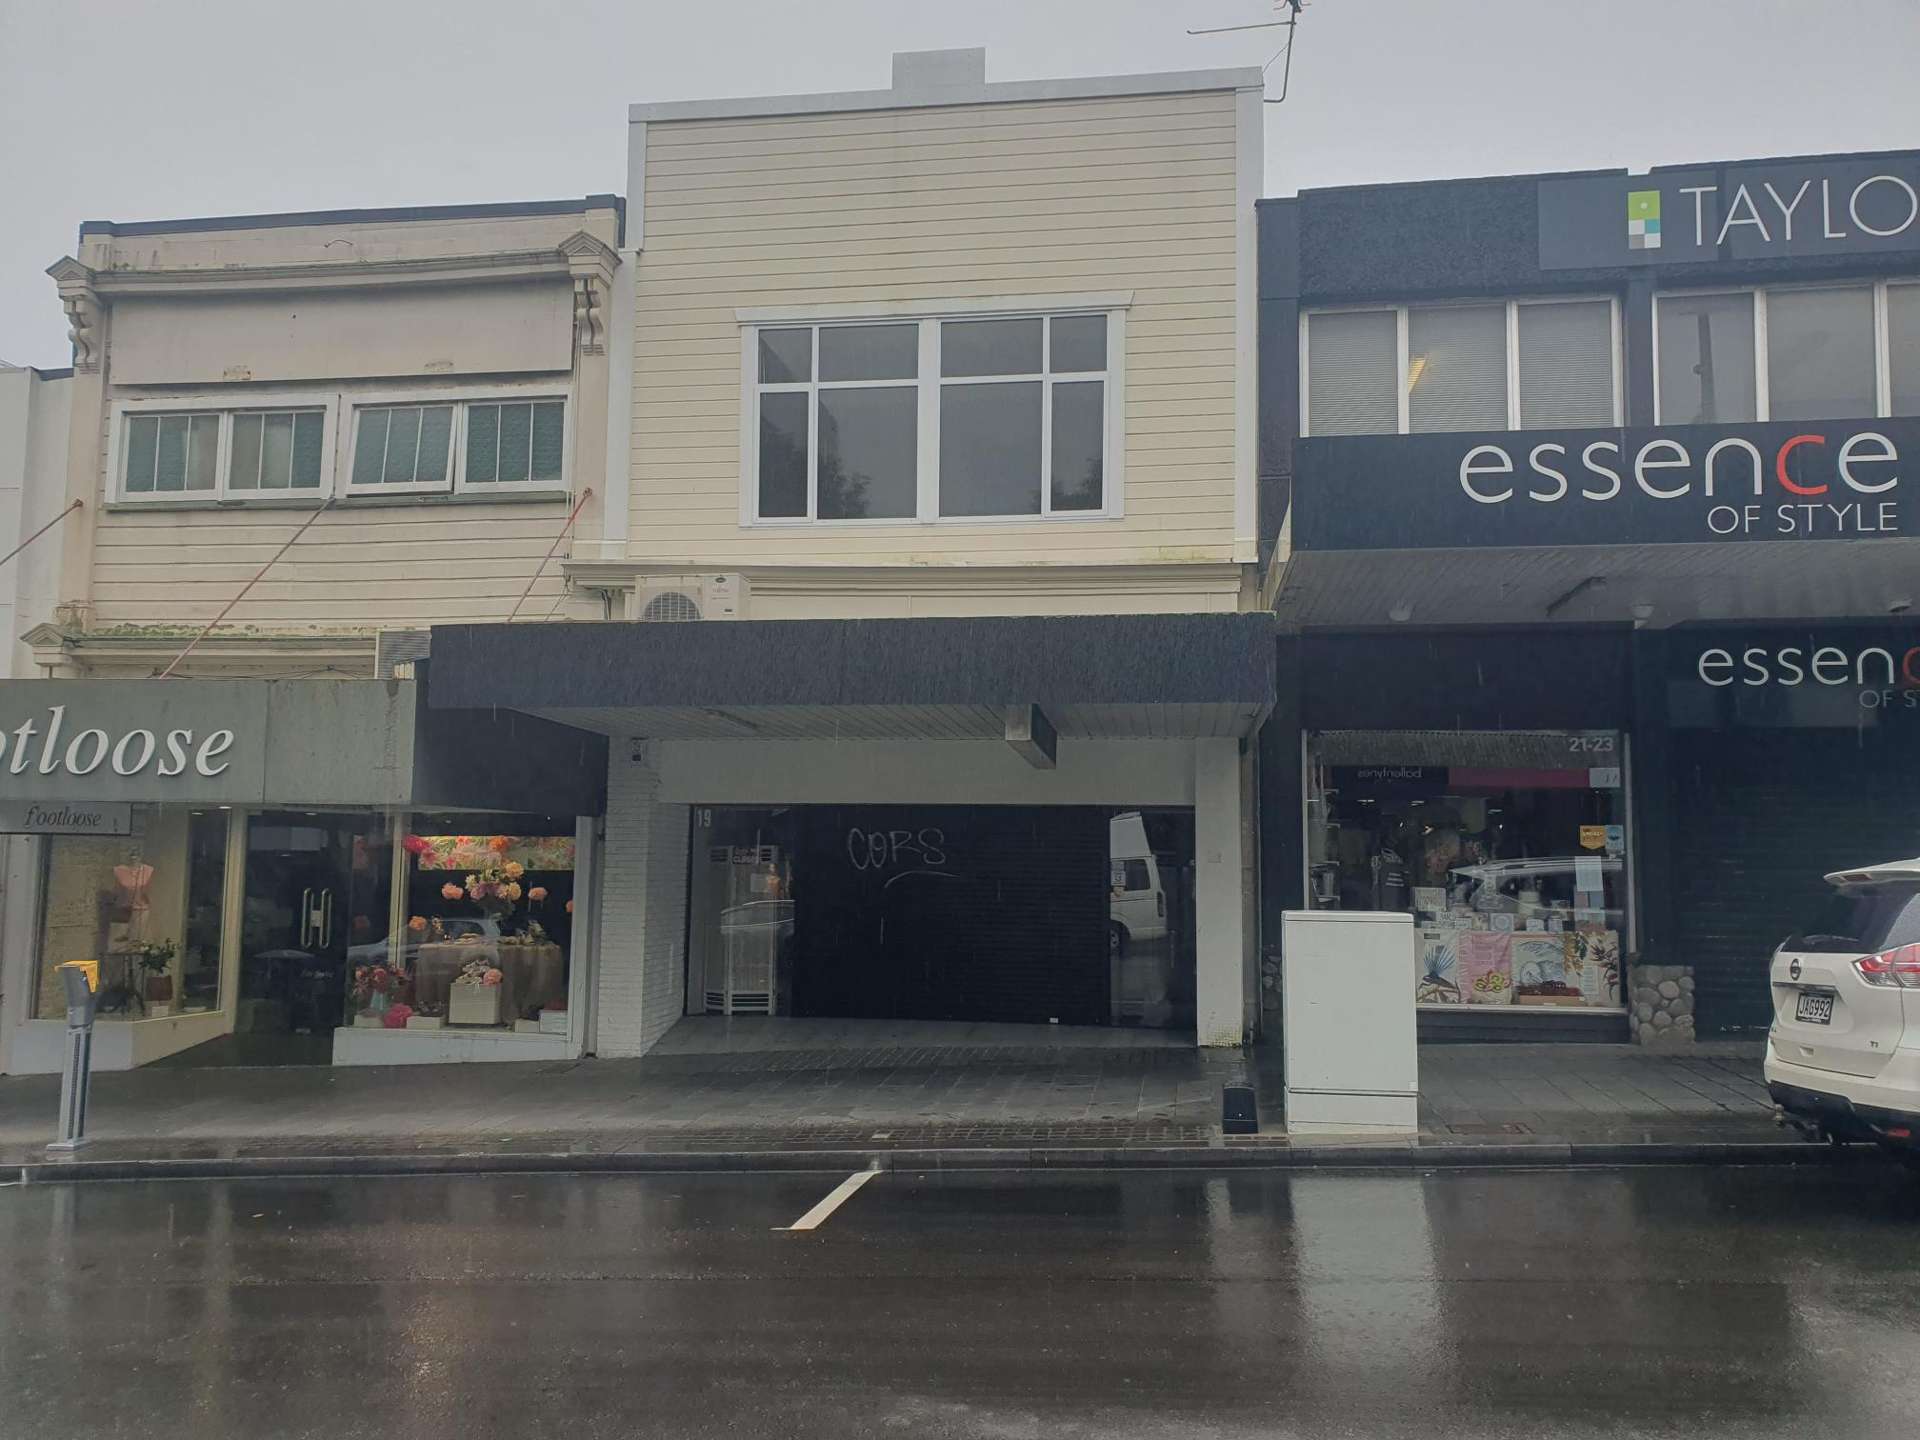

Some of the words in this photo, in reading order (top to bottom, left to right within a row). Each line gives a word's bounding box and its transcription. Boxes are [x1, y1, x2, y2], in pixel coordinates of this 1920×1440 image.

[1679, 175, 1918, 246] TAYLO
[1459, 432, 1898, 503] essence
[1707, 505, 1761, 534] OF
[1777, 502, 1898, 533] STYLE
[1859, 689, 1893, 708] OF
[0, 705, 234, 776] tloose
[1569, 737, 1613, 752] 21-23
[25, 806, 102, 829] footloose
[1799, 999, 1831, 1018] JAG992
